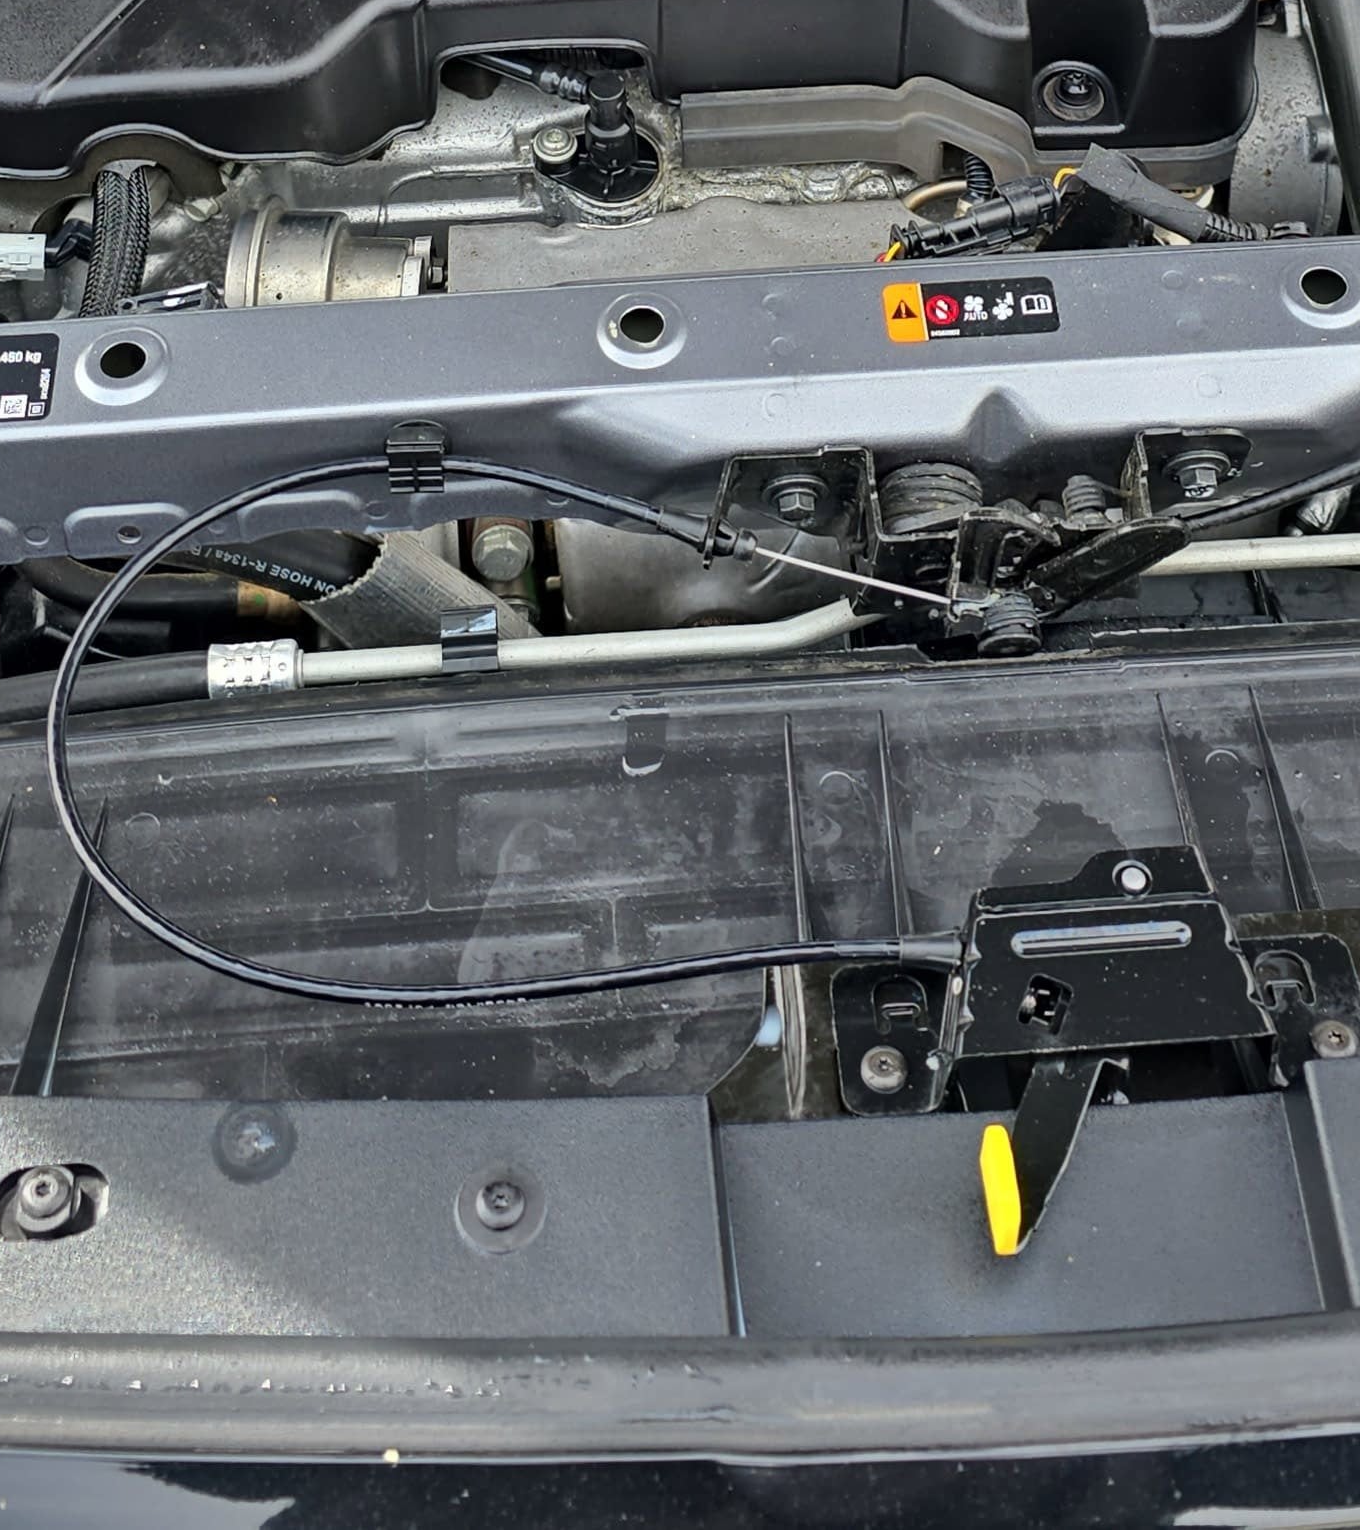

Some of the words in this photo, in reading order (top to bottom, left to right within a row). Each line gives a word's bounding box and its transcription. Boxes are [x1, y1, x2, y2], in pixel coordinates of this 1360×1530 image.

[963, 310, 988, 321] AUTO
[25, 350, 42, 365] kg
[215, 549, 268, 573] R-134a
[269, 564, 313, 587] HOSE
